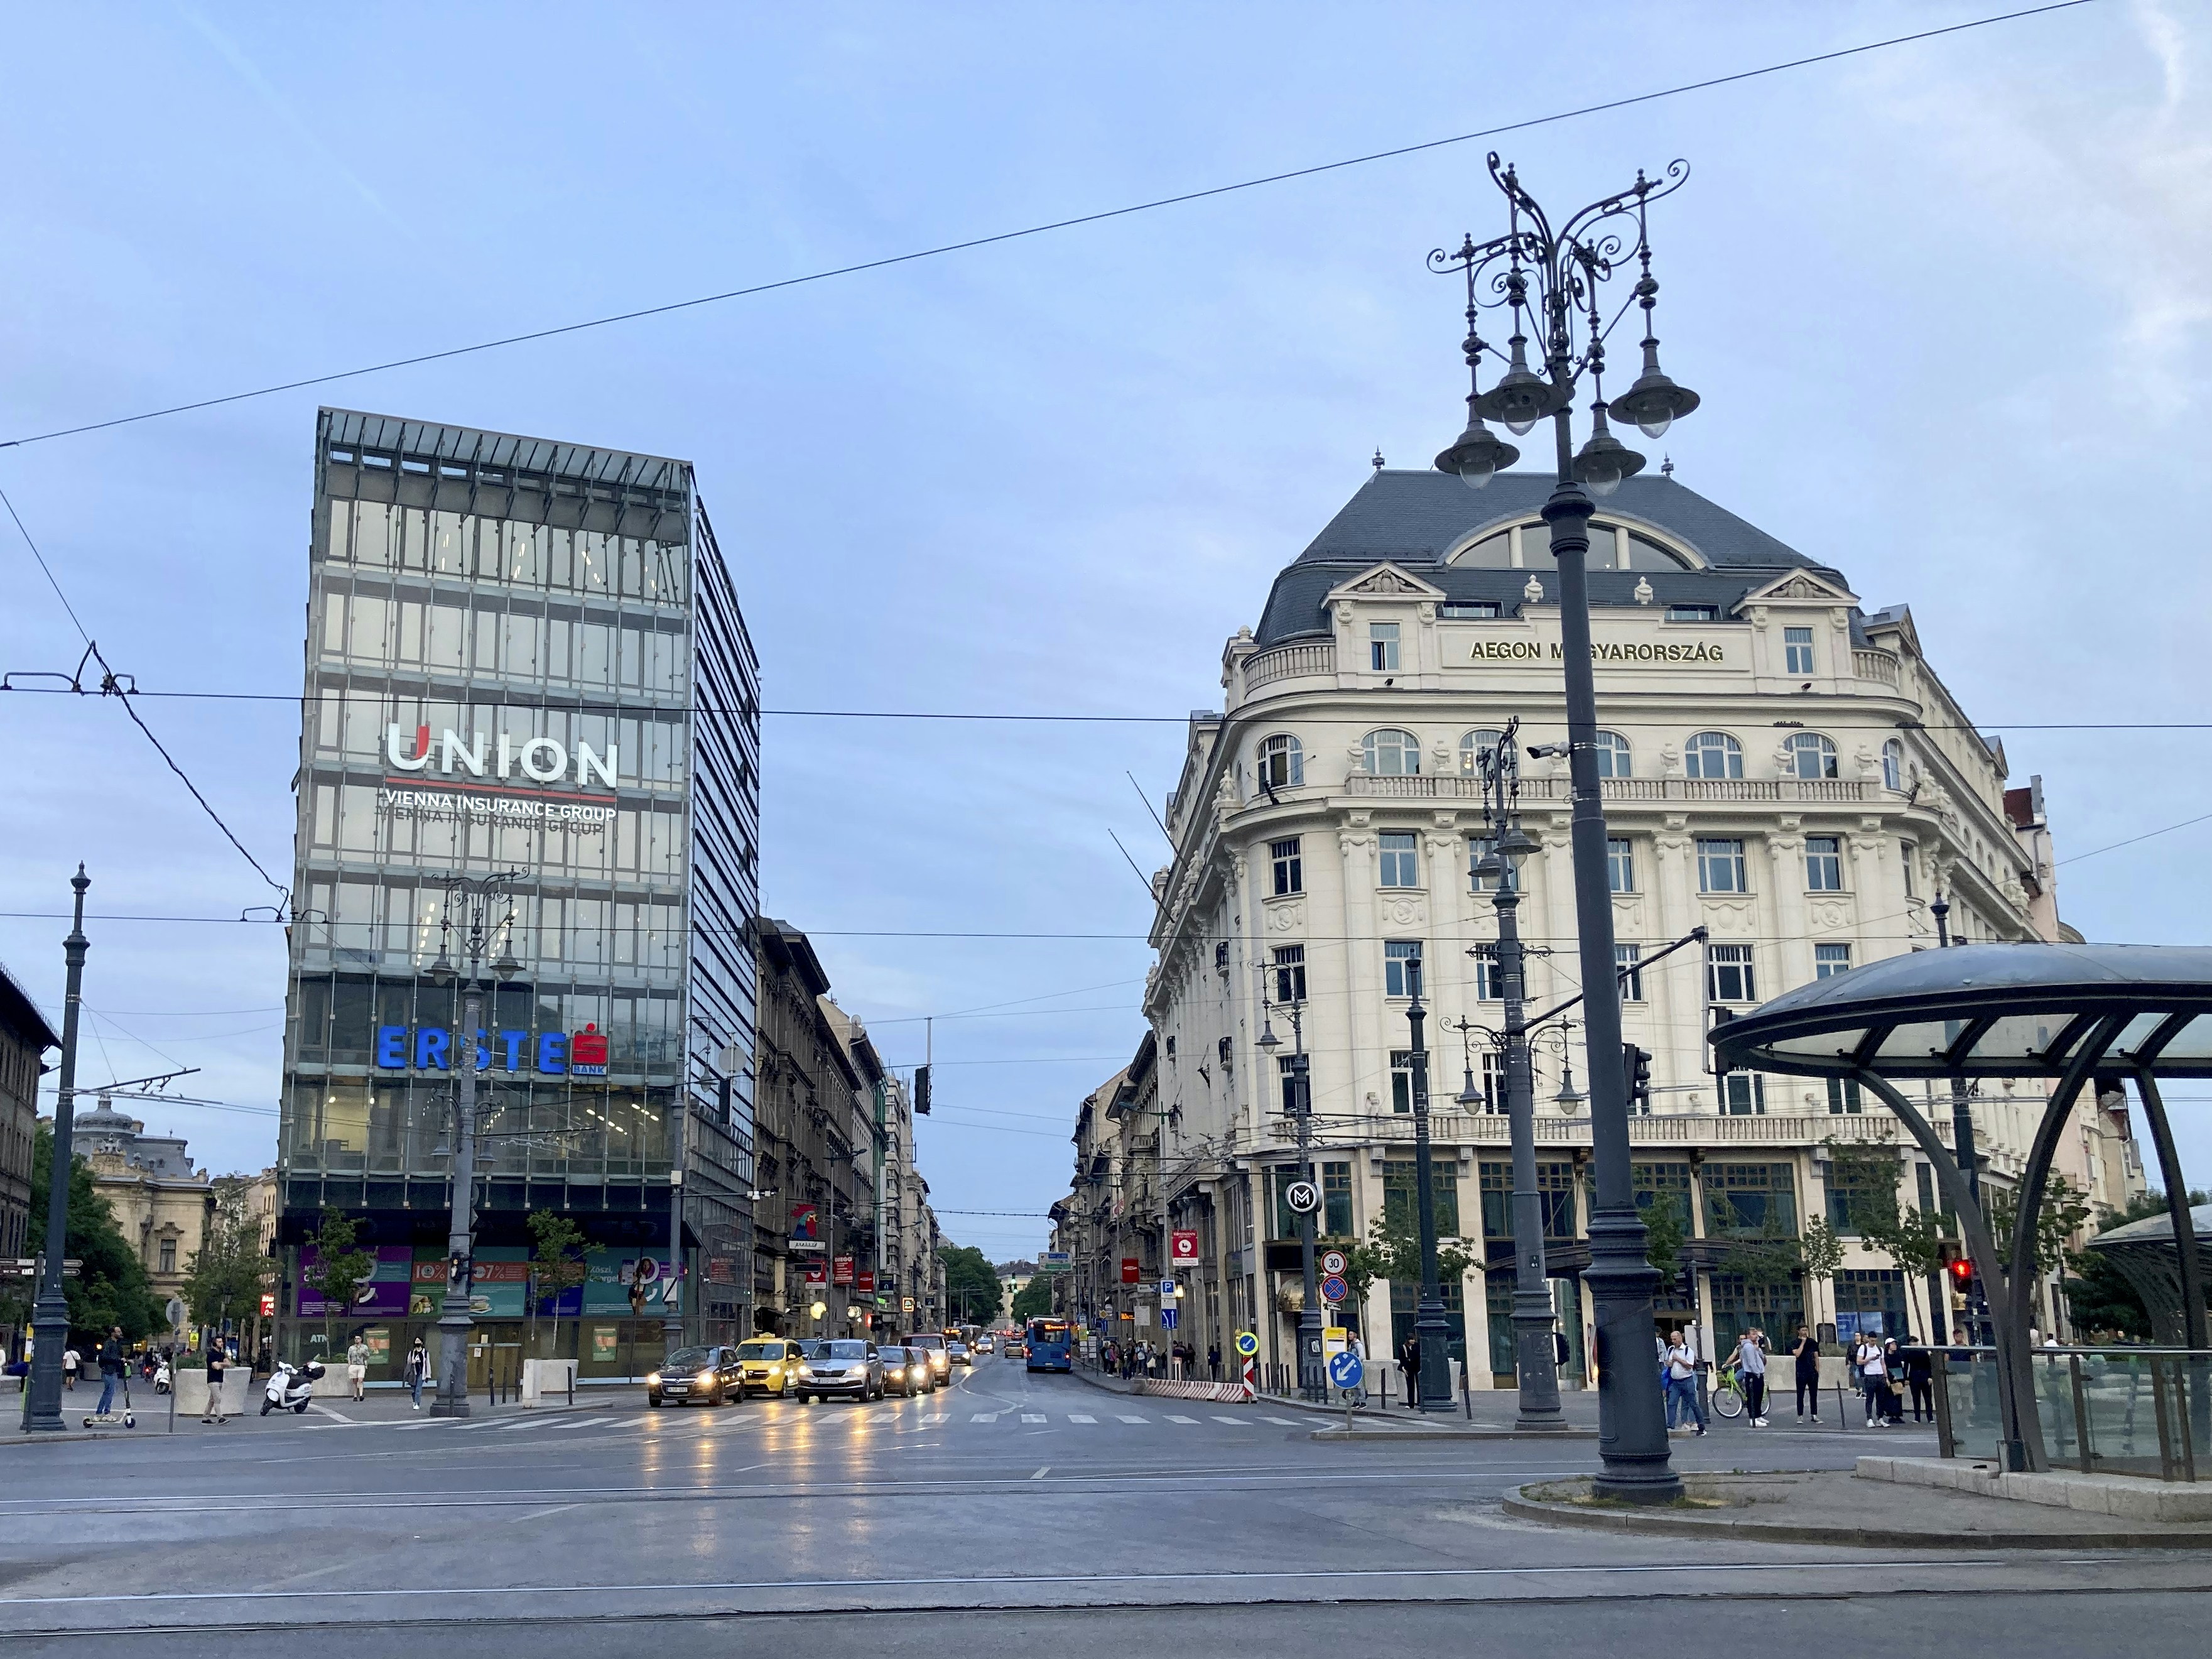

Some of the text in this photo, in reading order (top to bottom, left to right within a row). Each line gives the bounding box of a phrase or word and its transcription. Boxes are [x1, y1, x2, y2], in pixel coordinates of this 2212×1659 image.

[1470, 641, 1723, 661] AEGON MGYARORSZÁG
[388, 722, 618, 789] UNION
[385, 789, 617, 822] VIENNA INSURANCE GROUP
[573, 1065, 605, 1074] BANK
[1328, 1258, 1340, 1268] 30
[1164, 1283, 1171, 1292] P
